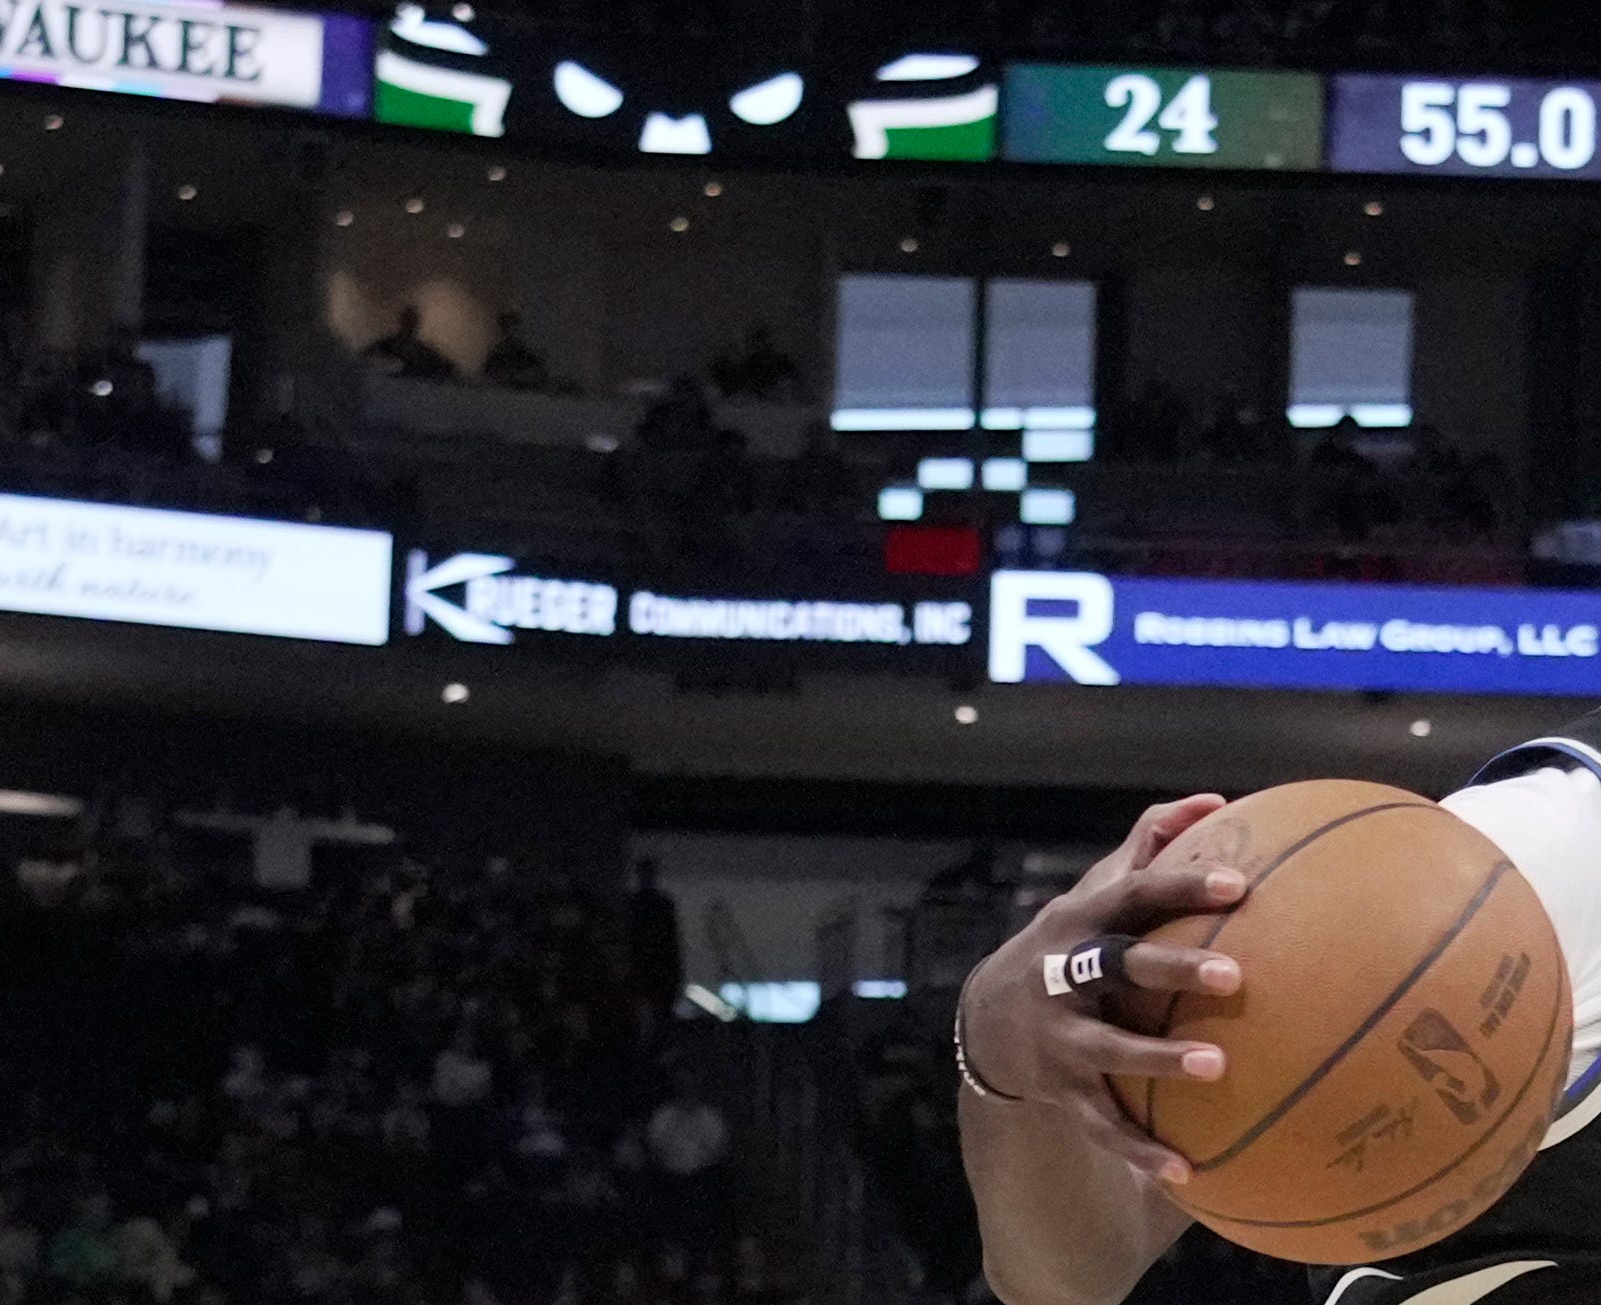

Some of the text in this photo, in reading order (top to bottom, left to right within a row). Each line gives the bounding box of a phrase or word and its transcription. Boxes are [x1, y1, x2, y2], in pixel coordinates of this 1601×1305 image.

[1104, 74, 1218, 157] 24
[1400, 82, 1597, 170] 55.0
[988, 570, 1119, 685] R
[1517, 624, 1599, 657] LLC
